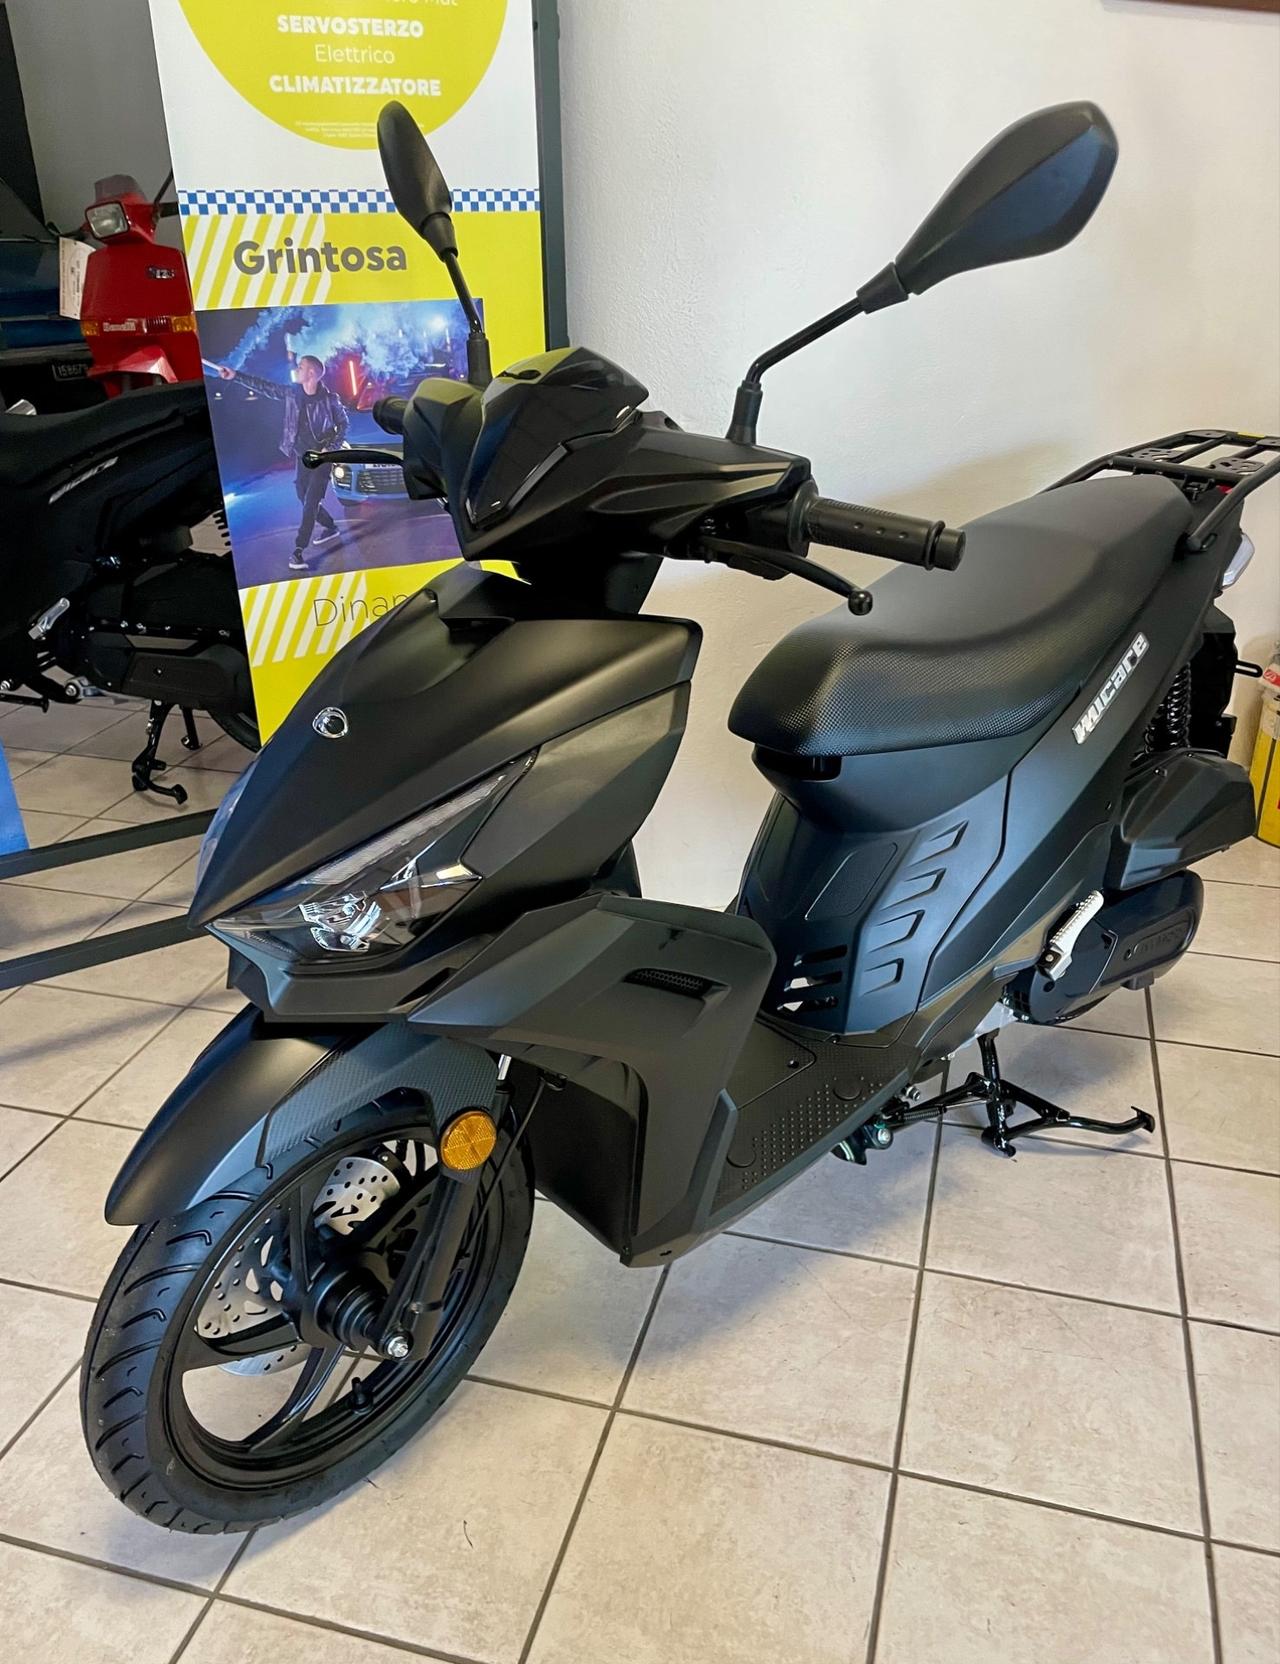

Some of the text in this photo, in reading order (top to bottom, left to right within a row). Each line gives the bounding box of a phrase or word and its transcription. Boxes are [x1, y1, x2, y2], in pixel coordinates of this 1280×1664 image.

[277, 15, 424, 38] SERVOSTERZO
[315, 44, 395, 64] Elettrico
[269, 75, 441, 96] CLIMATIZZATORE
[233, 237, 407, 275] Grintosa
